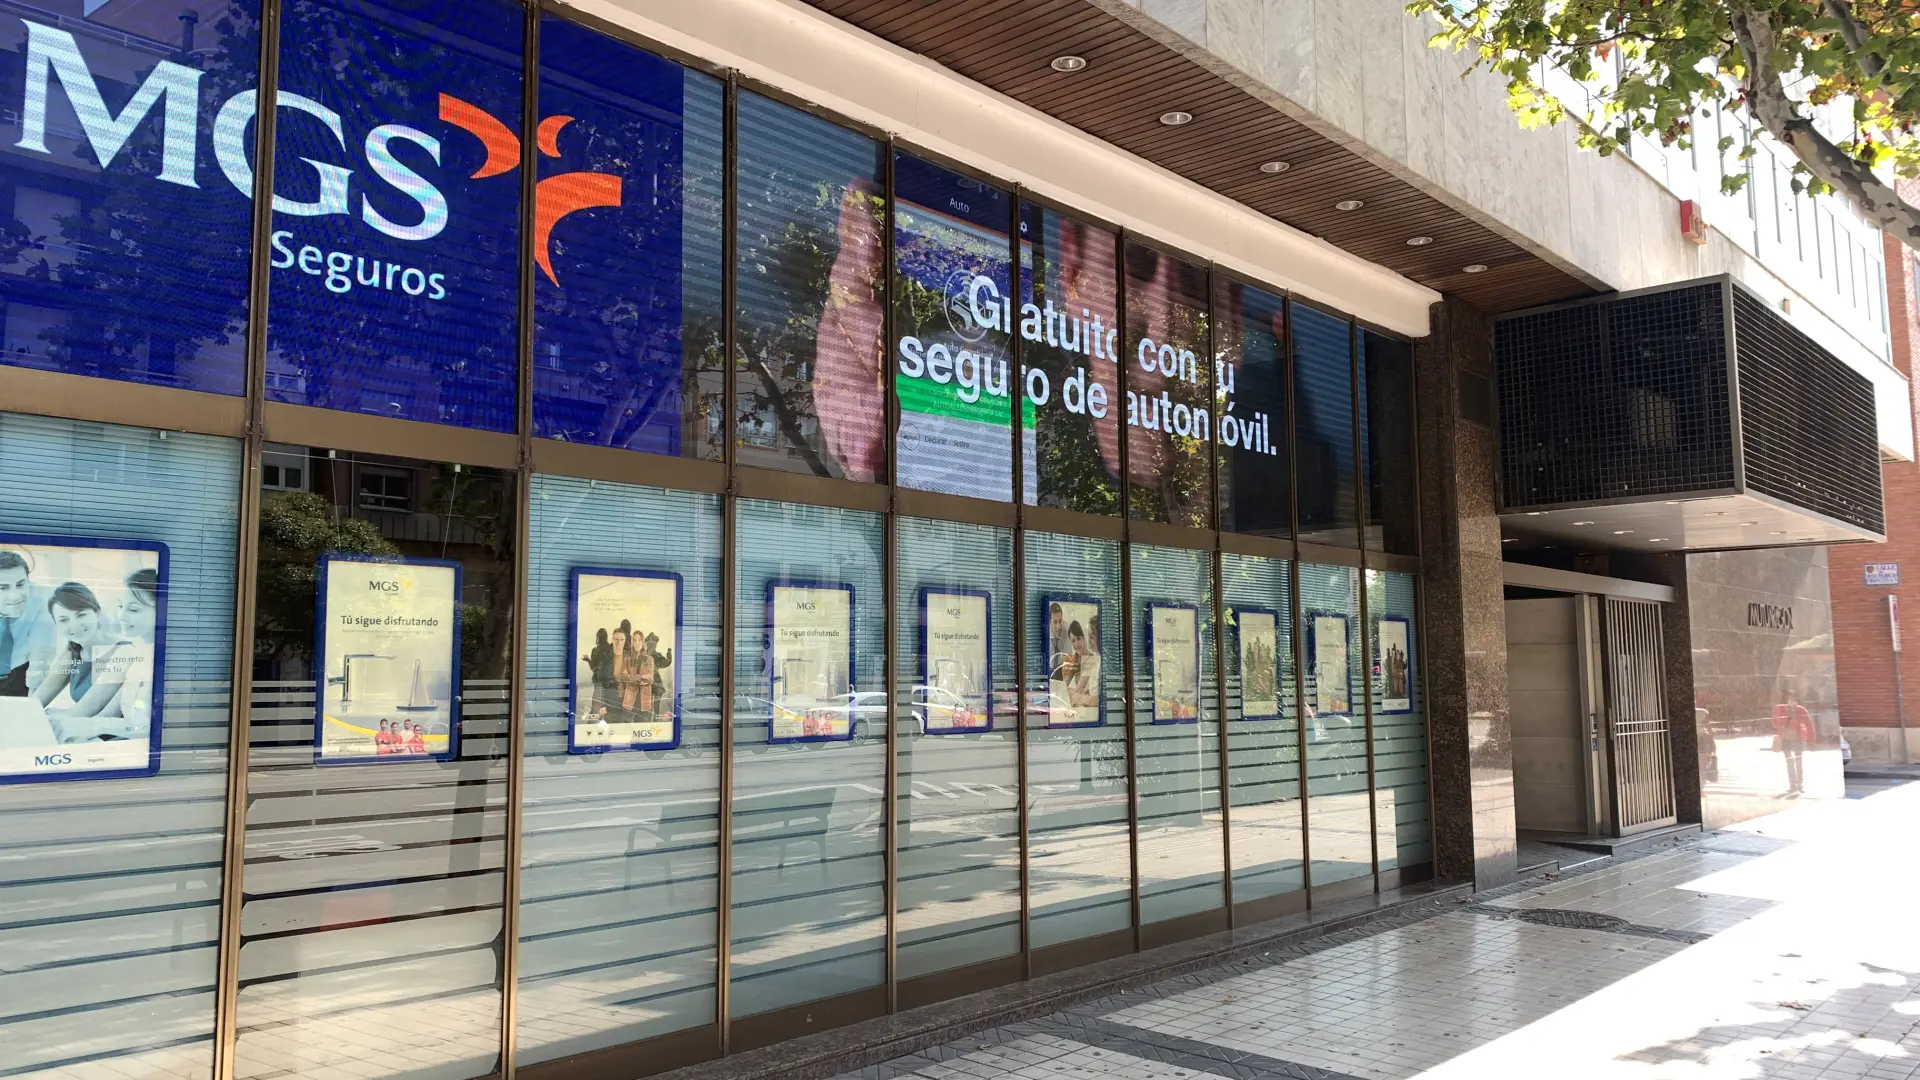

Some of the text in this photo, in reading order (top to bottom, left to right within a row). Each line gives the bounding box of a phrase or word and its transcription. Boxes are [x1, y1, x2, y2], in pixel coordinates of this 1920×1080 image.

[14, 18, 449, 241] MGS
[949, 197, 970, 213] Auto
[270, 230, 447, 300] Seguros
[1138, 337, 1197, 384] con
[898, 335, 1050, 406] seguo
[1062, 366, 1108, 418] de
[369, 580, 399, 591] MGS
[796, 602, 816, 610] MGS
[340, 615, 439, 628] Tú sigue disfrutando
[632, 729, 652, 738] MGS
[35, 754, 72, 766] MGS
